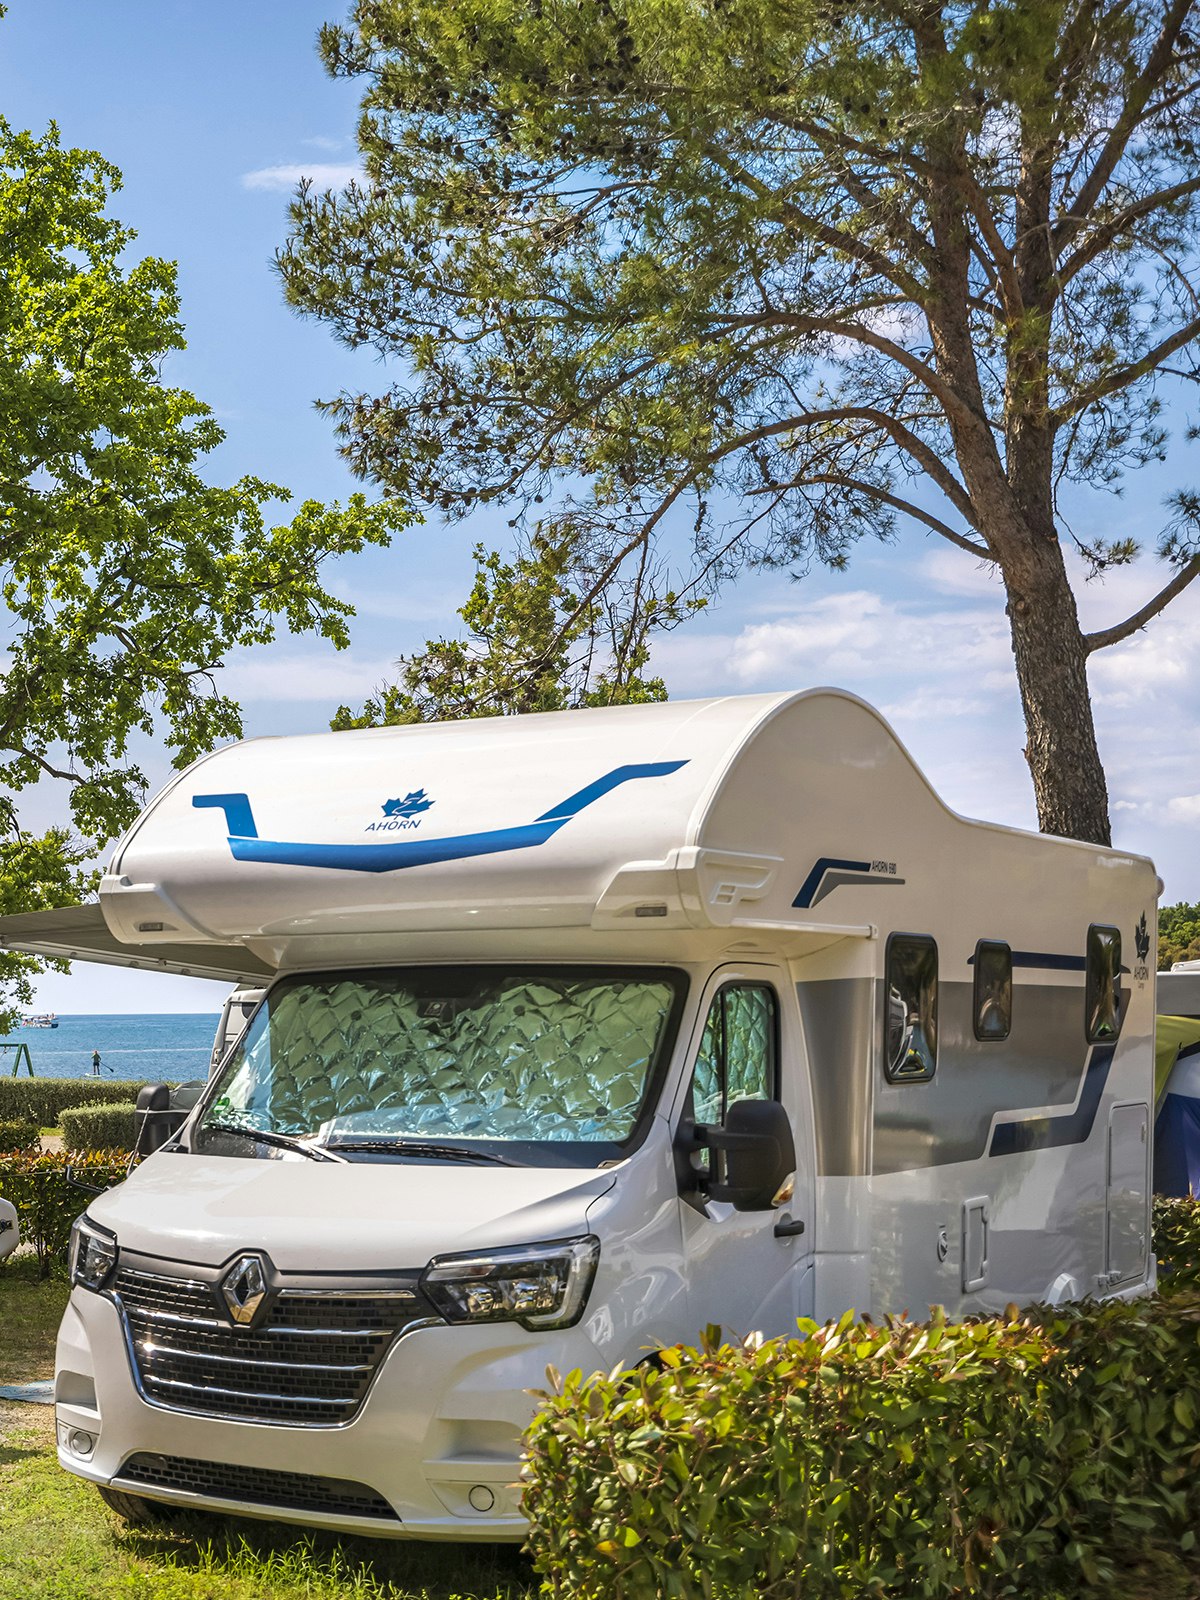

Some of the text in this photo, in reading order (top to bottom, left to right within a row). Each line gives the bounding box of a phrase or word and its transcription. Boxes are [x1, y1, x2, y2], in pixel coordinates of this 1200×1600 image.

[365, 820, 421, 831] AHORN
[871, 860, 887, 873] AHORN
[1133, 966, 1149, 980] AHORN
